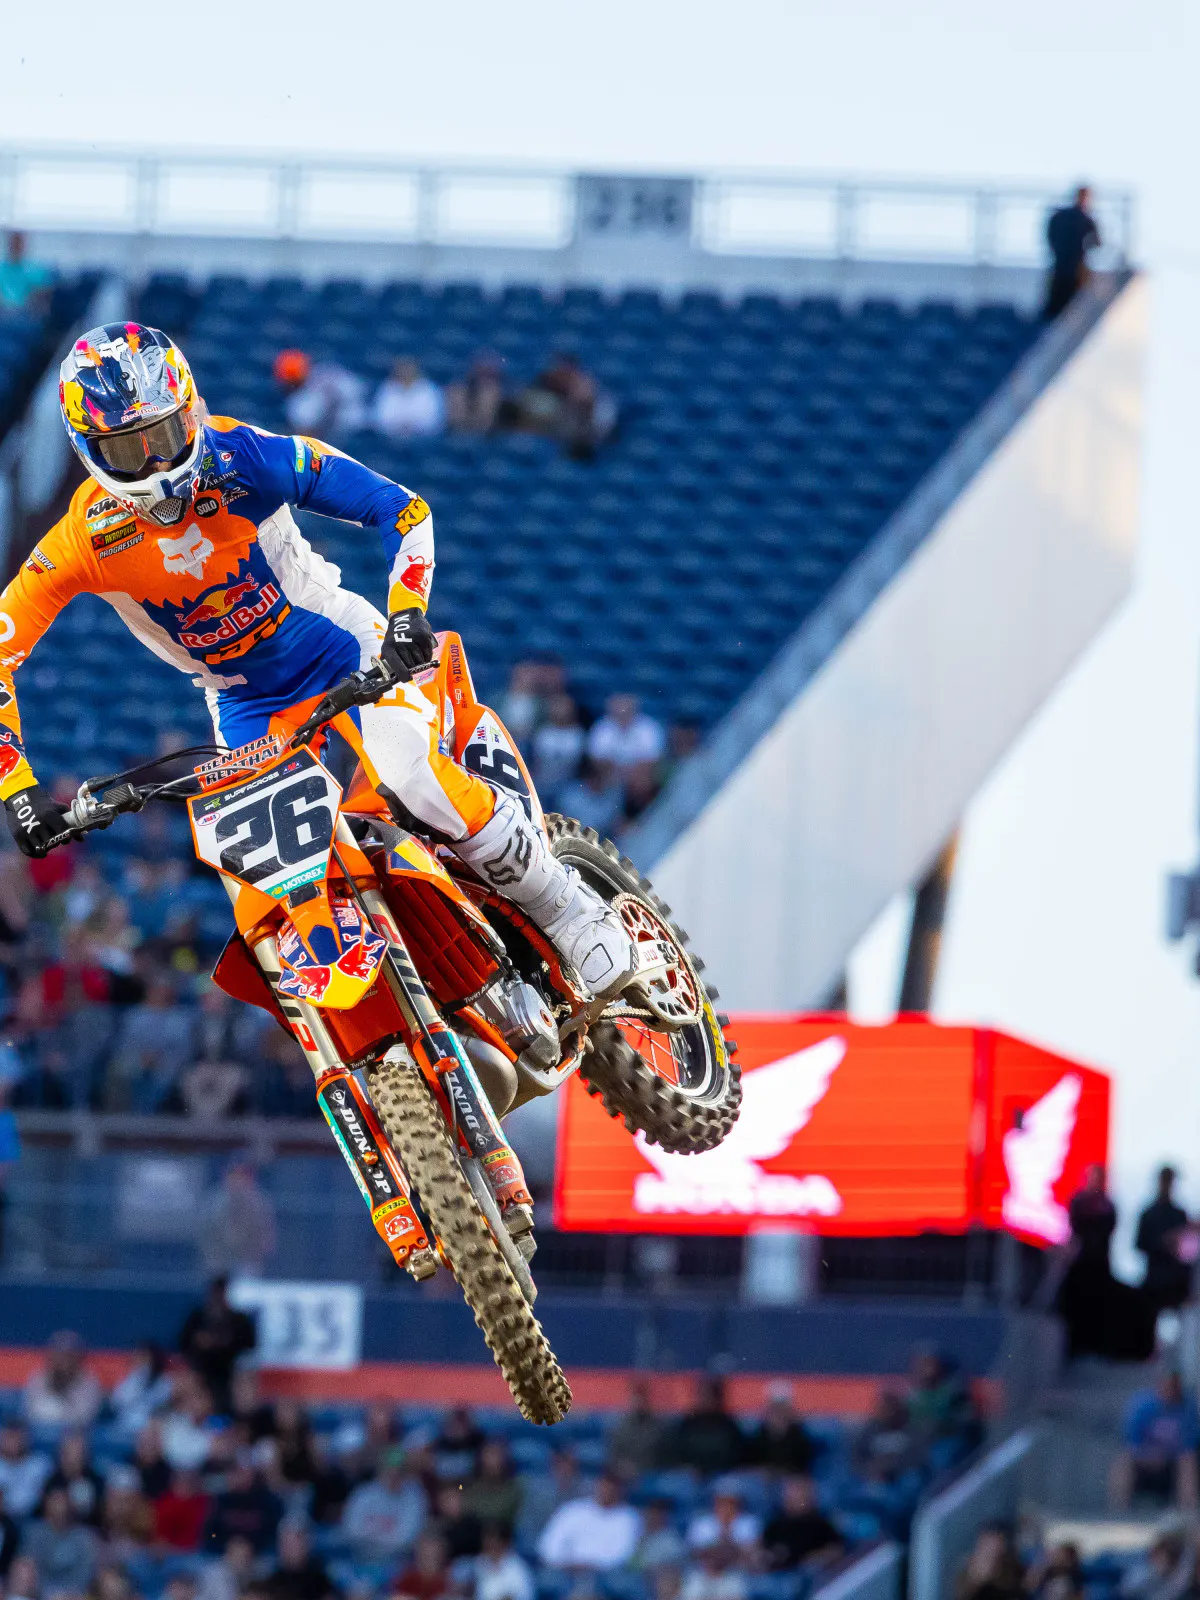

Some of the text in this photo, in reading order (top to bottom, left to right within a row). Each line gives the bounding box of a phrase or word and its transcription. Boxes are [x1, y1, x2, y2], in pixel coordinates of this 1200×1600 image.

[121, 405, 159, 422] Red Bull
[87, 497, 119, 519] KTM
[93, 510, 132, 531] MOTOREX
[196, 499, 217, 516] SOLO
[99, 532, 144, 560] PROGRESSIVE
[178, 582, 280, 647] Red Bull
[394, 614, 413, 643] FOX
[450, 643, 462, 675] DUNLOP
[201, 733, 279, 773] RENTHAL
[205, 743, 282, 786] RENTHAL
[12, 794, 40, 833] FOX
[214, 775, 334, 885] 26
[282, 866, 324, 891] MOTOREX
[462, 990, 482, 1005] Twin
[350, 1051, 377, 1070] Twin Air
[374, 1199, 407, 1221] ACERBIS
